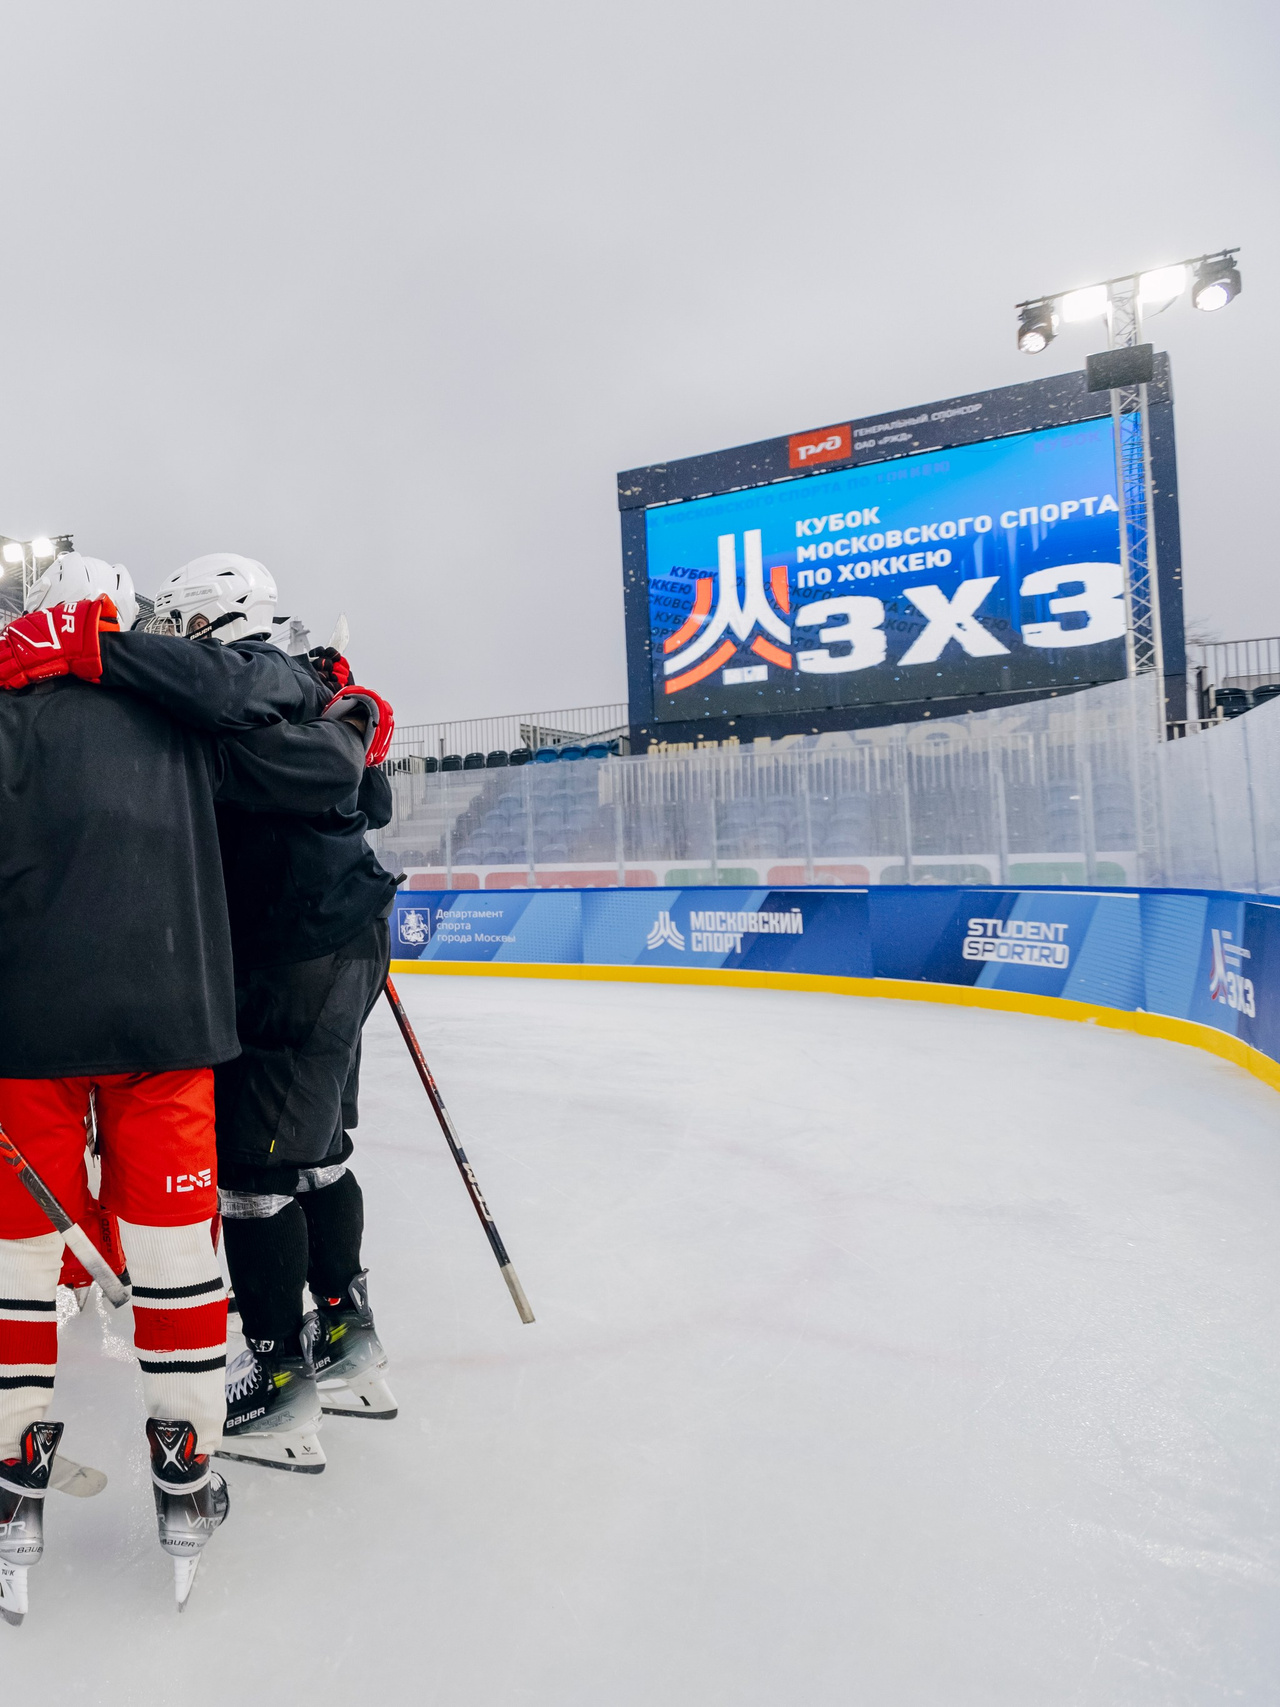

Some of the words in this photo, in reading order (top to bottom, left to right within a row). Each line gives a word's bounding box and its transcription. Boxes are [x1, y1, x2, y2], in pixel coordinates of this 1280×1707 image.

[853, 413, 928, 438] ГЕНЕРАЛЬНЫЙ
[931, 403, 983, 421] СПОНСОР
[853, 439, 876, 451] ОАО
[795, 506, 881, 538] КУБОК
[796, 514, 993, 563] МОСКОВСКОГО
[1000, 494, 1120, 530] СПОРТА
[797, 566, 832, 589] ПО
[837, 549, 952, 583] ХОККЕЮ
[436, 908, 504, 920] Департамент
[689, 907, 804, 935] МОСКОВСКИЙ
[436, 922, 472, 932] спорта
[437, 933, 472, 944] города
[474, 932, 516, 943] Москвы
[966, 918, 1069, 942] STUDENT
[691, 931, 744, 954] СПОРТ
[966, 940, 1067, 966] SPORT.RU
[314, 1356, 332, 1371] UER
[226, 1406, 266, 1429] BAUER
[16, 1546, 43, 1554] BAUE
